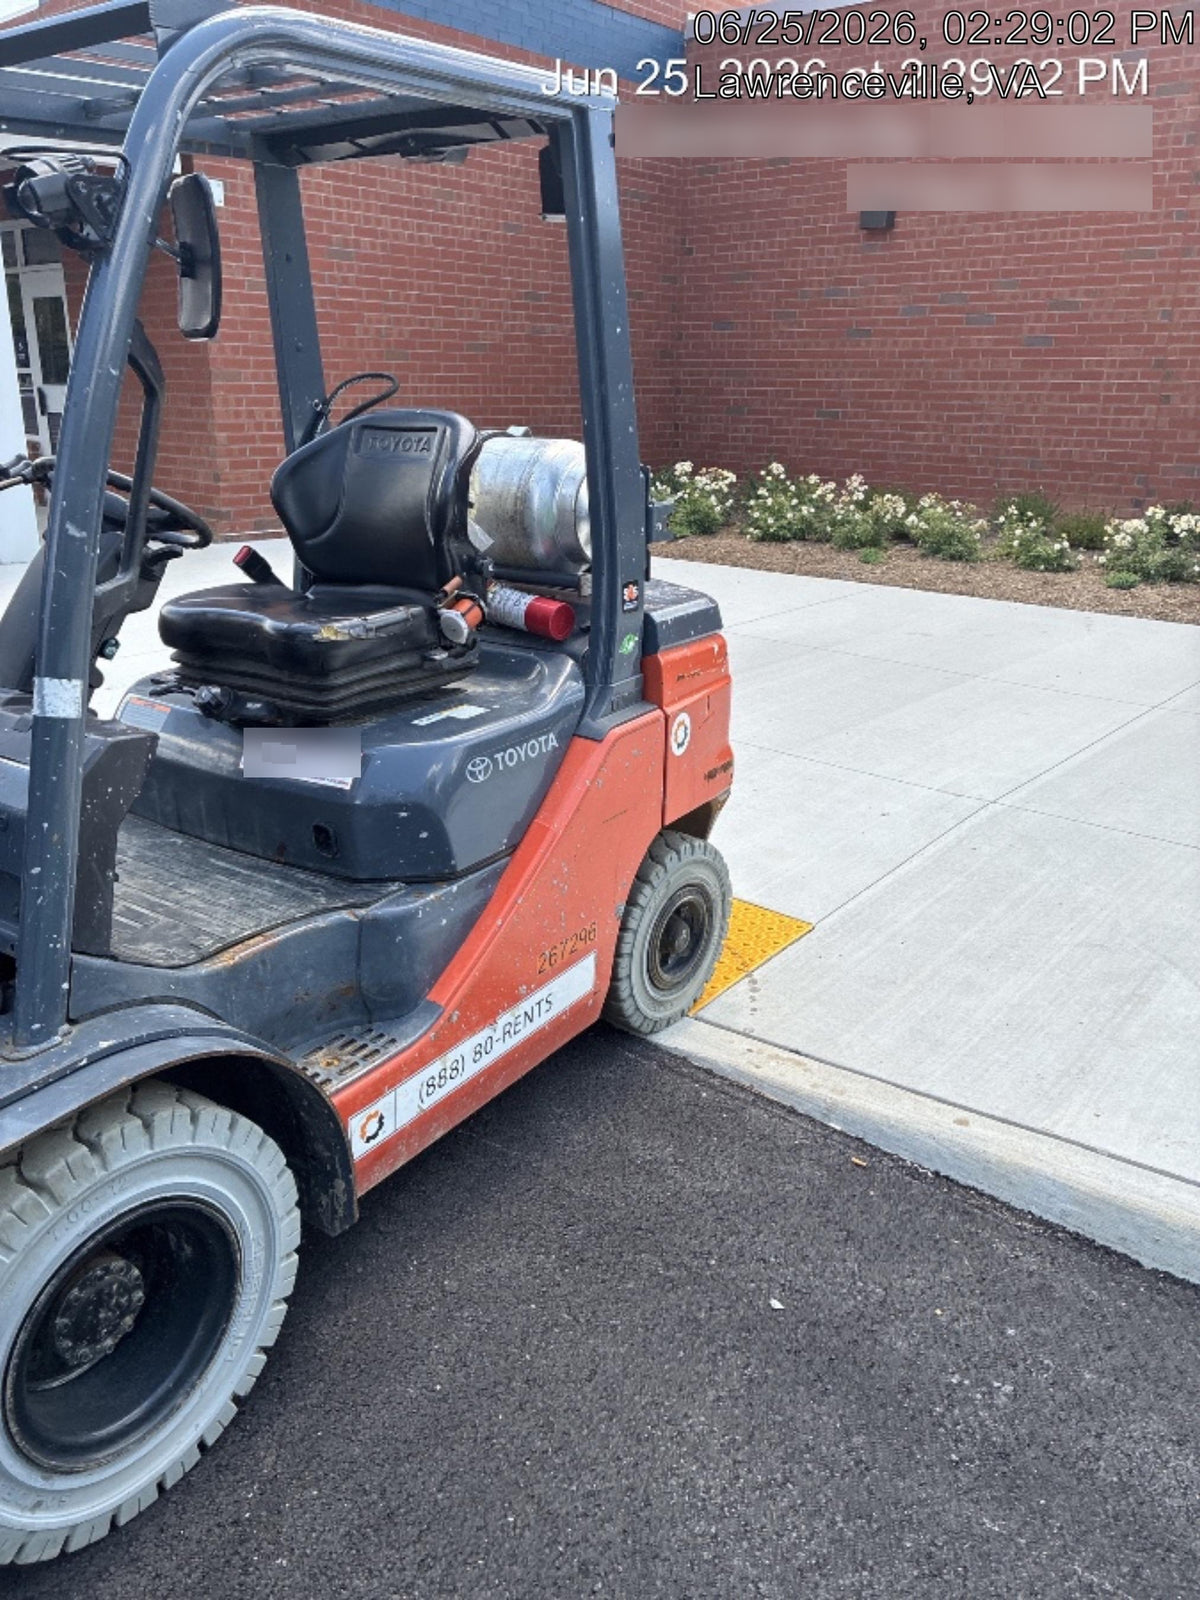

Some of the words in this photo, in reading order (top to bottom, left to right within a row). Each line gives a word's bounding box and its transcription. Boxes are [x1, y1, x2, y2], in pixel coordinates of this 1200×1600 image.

[368, 436, 431, 453] TOYOTA
[493, 732, 559, 771] TOYOTA
[537, 921, 597, 975] 267296
[418, 1054, 466, 1104] (888)
[472, 992, 555, 1065] 80-RENTS
